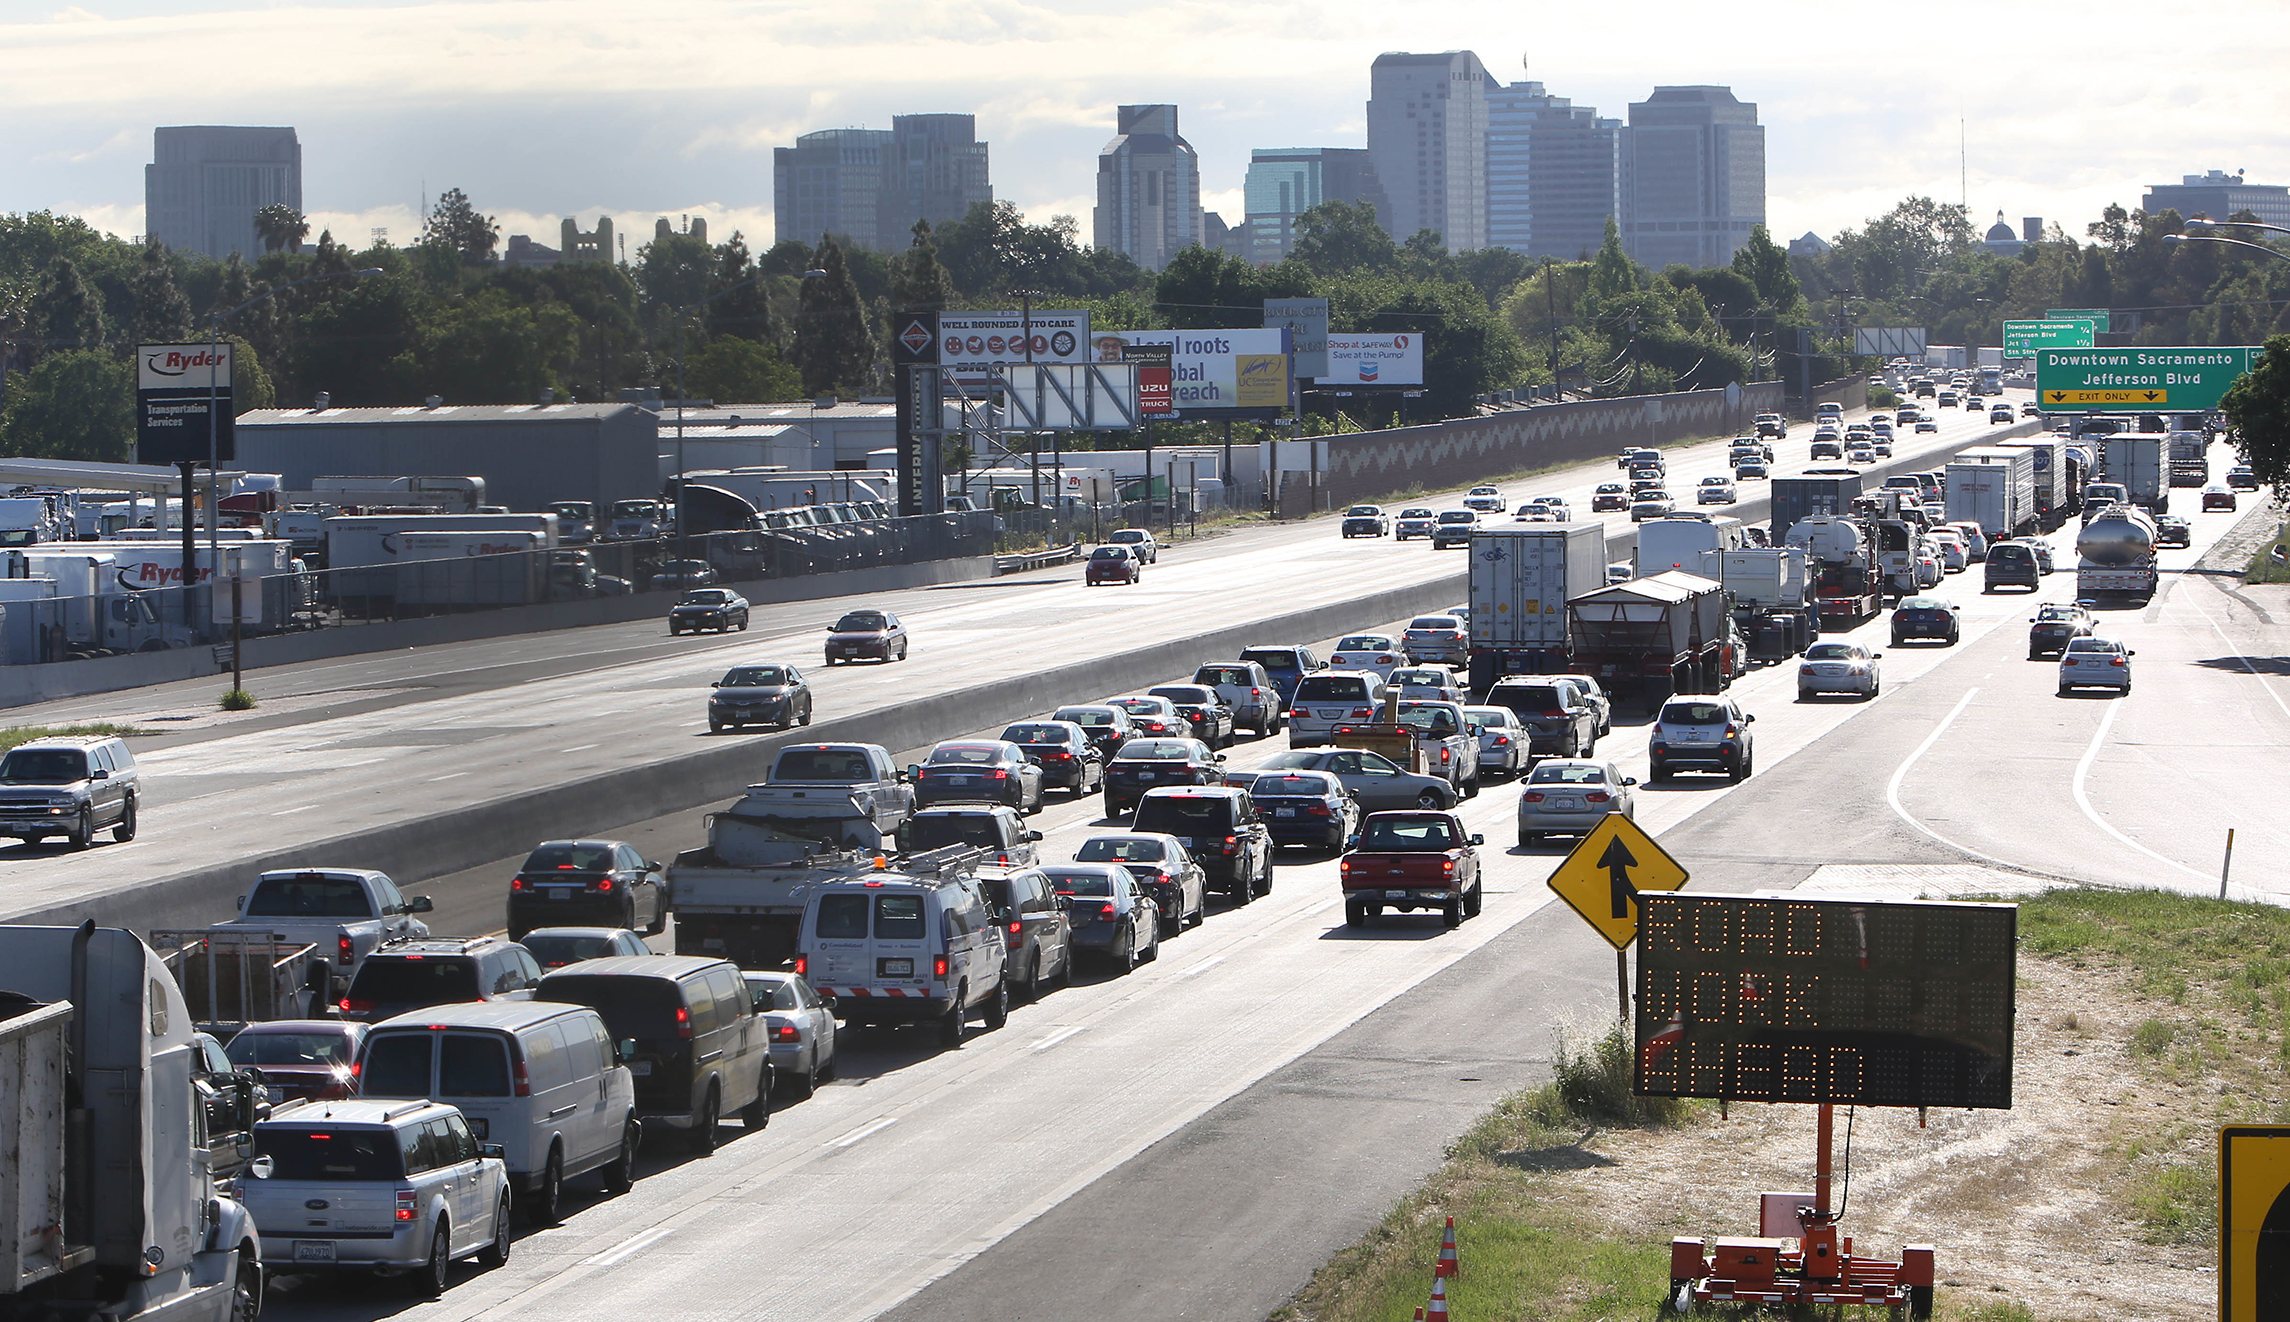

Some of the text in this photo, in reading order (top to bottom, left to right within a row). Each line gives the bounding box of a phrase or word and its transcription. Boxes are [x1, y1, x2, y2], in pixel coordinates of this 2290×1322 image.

[1264, 306, 1325, 317] RIVER CITY
[942, 321, 969, 329] WELL
[971, 320, 1019, 329] ROUNDED
[1186, 337, 1230, 354] roots
[1328, 340, 1349, 349] Shop
[1351, 340, 1359, 348] at
[166, 351, 226, 371] Ryder
[2049, 353, 2233, 366] Downtown Sacramento
[1239, 378, 1253, 387] UC
[2082, 373, 2201, 385] Jefferson Blvd
[1172, 382, 1219, 400] reach
[2105, 392, 2130, 401] ONLY
[147, 403, 207, 416] Transportation
[148, 416, 183, 427] Services
[1647, 899, 1821, 956] ROAD
[1646, 969, 1820, 1027] WORK
[1643, 1039, 1864, 1099] AHEAD
